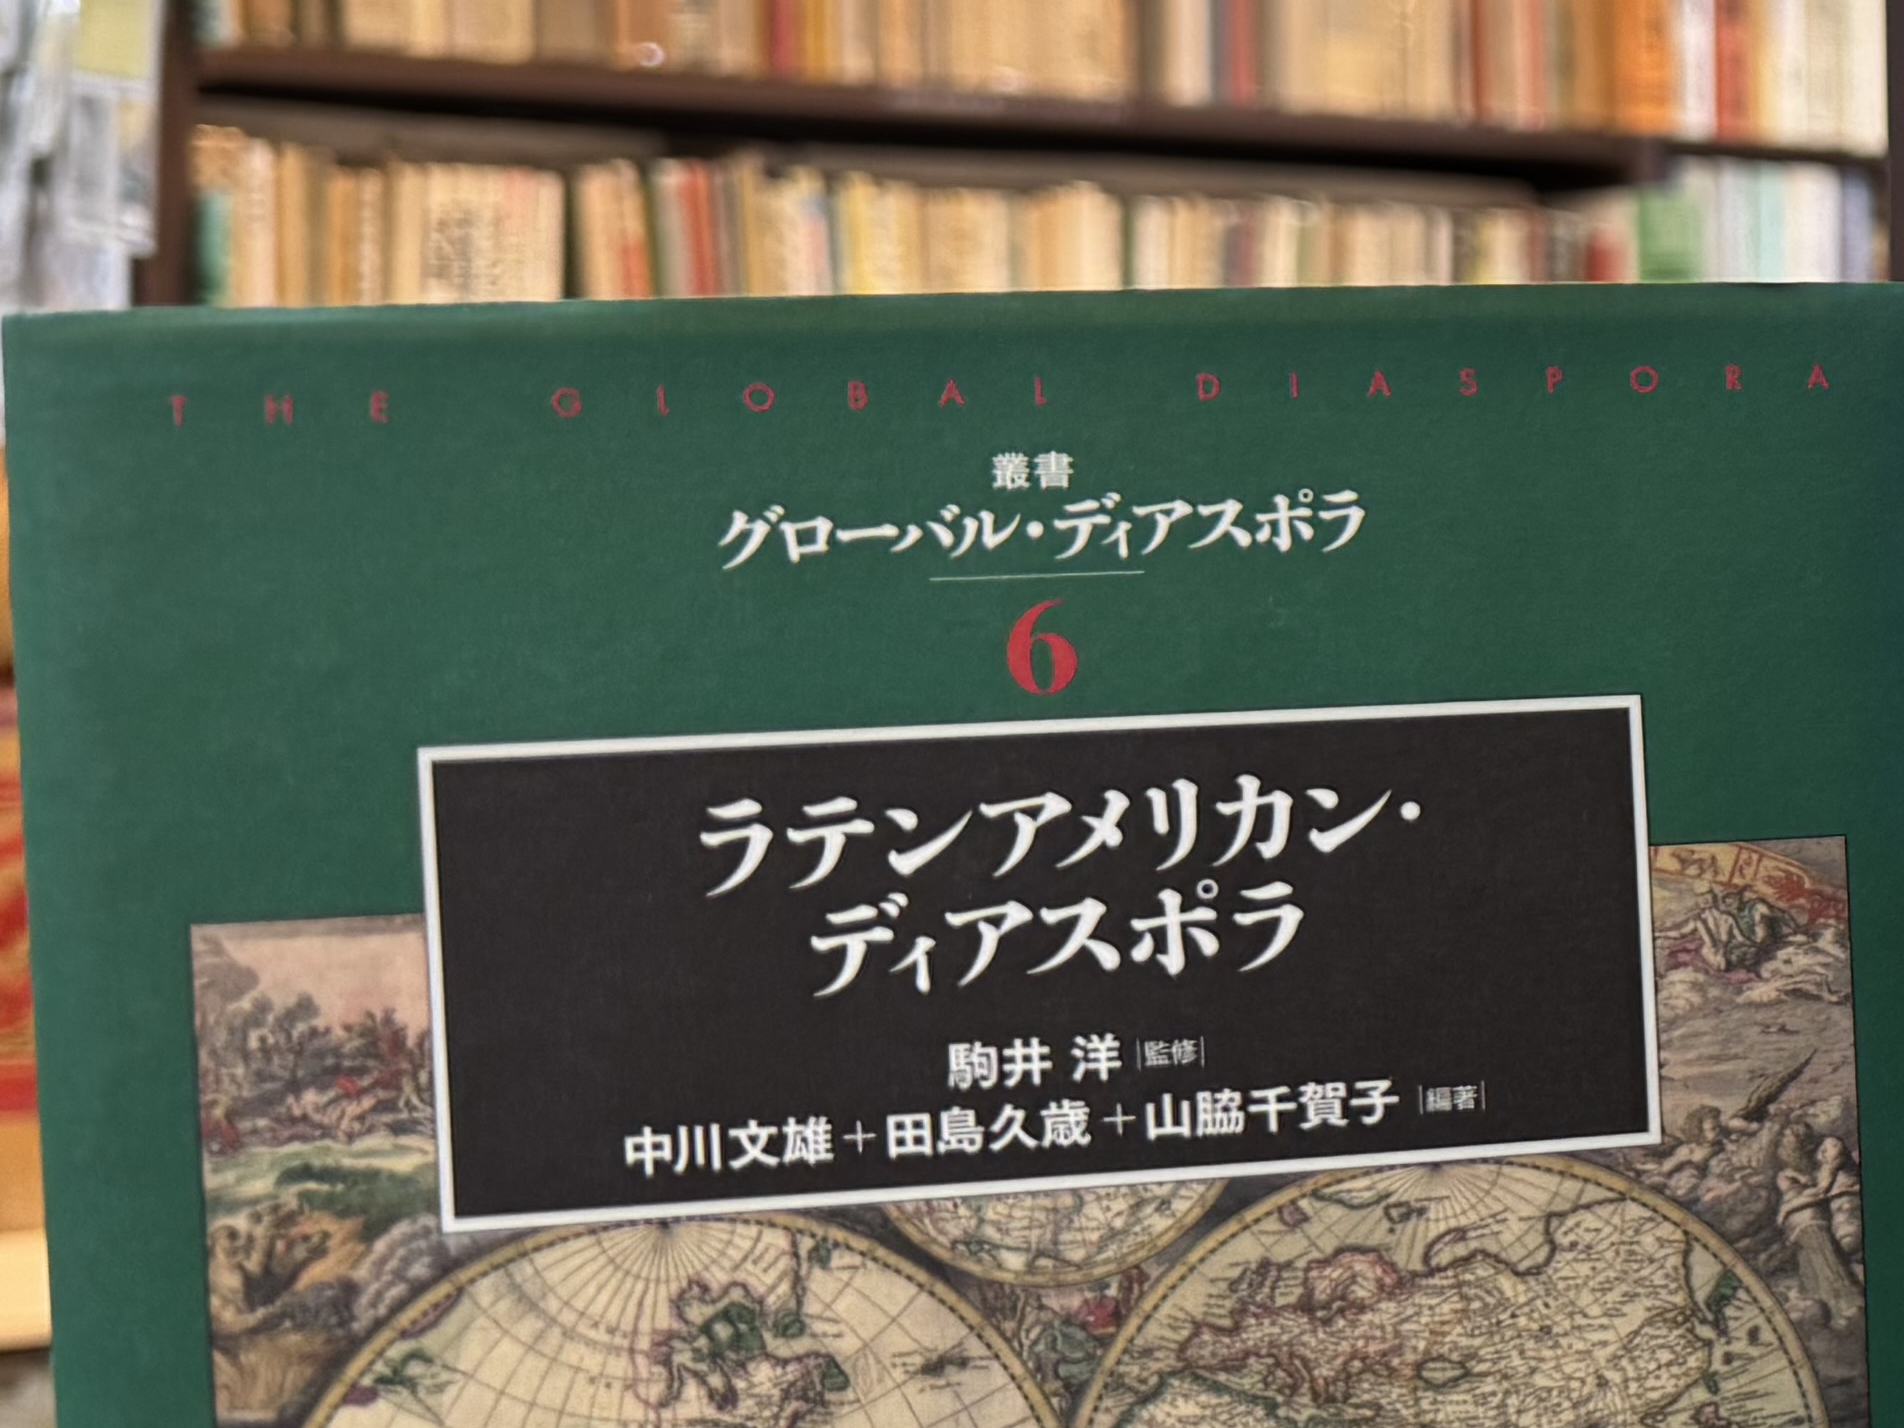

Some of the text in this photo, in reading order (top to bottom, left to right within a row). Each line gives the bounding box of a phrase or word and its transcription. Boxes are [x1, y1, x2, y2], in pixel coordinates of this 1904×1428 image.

[168, 361, 1832, 428] THE GLOBAL DIASPORA
[991, 451, 1076, 491] 叢書
[717, 490, 1367, 572] グローバル・ディアスポラ
[1004, 598, 1079, 696] 6
[811, 886, 1306, 1001] ディアスポラ
[1141, 1037, 1203, 1071] 監修
[1422, 1081, 1483, 1118] 編著
